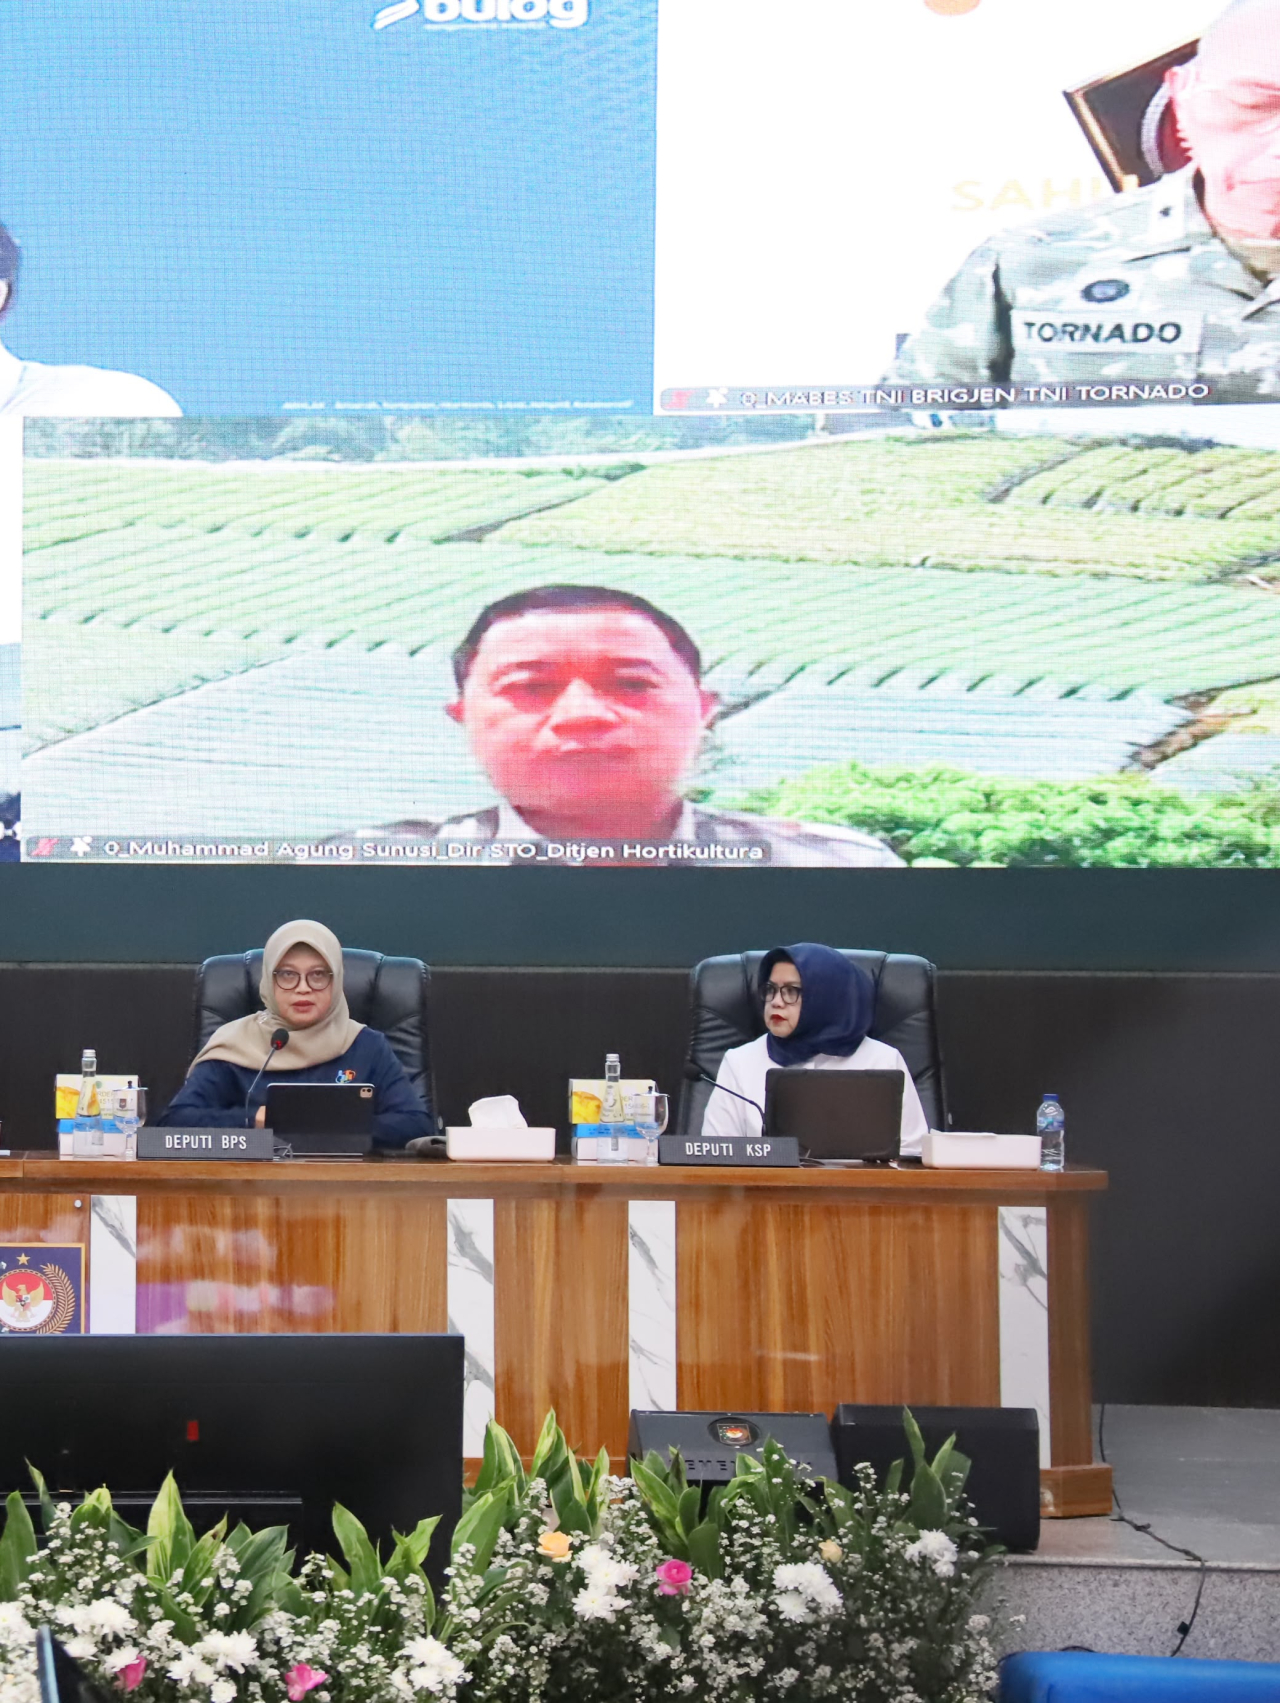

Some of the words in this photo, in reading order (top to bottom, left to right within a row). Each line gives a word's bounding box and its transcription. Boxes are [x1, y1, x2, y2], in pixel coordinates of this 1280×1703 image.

[1023, 322, 1182, 343] TORNADO
[860, 389, 903, 404] TNI
[911, 387, 1015, 403] BRIGJEN
[1024, 386, 1067, 402] TNI
[1076, 383, 1210, 400] TORNADO
[277, 842, 353, 860] Agung
[363, 842, 482, 860] Sunusi_Dir
[490, 842, 614, 861] STO_Ditjen
[623, 843, 763, 860] Hortikultura
[165, 1134, 212, 1149] DEPUTI
[221, 1135, 247, 1150] BPS
[685, 1142, 733, 1156] DEPUTI
[746, 1144, 771, 1157] KSP
